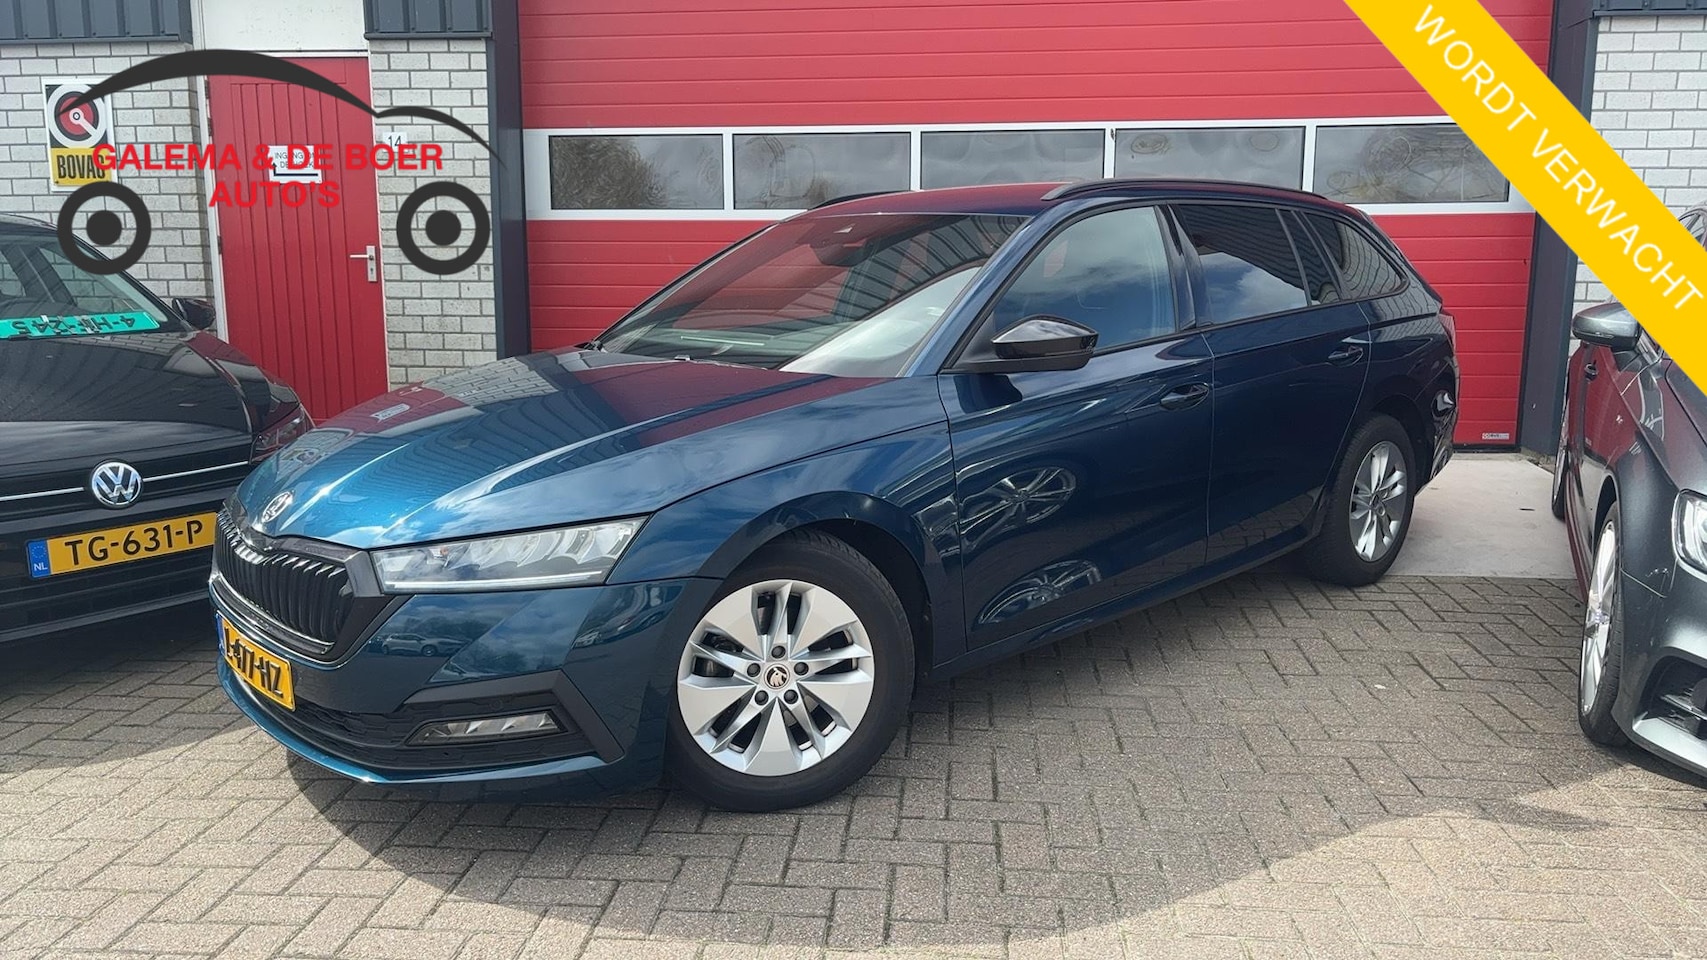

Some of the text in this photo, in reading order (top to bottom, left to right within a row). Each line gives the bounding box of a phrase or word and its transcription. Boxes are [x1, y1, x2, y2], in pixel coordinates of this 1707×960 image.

[275, 152, 304, 160] INGNG
[64, 520, 203, 566] TG-631-P
[34, 563, 48, 571] NL
